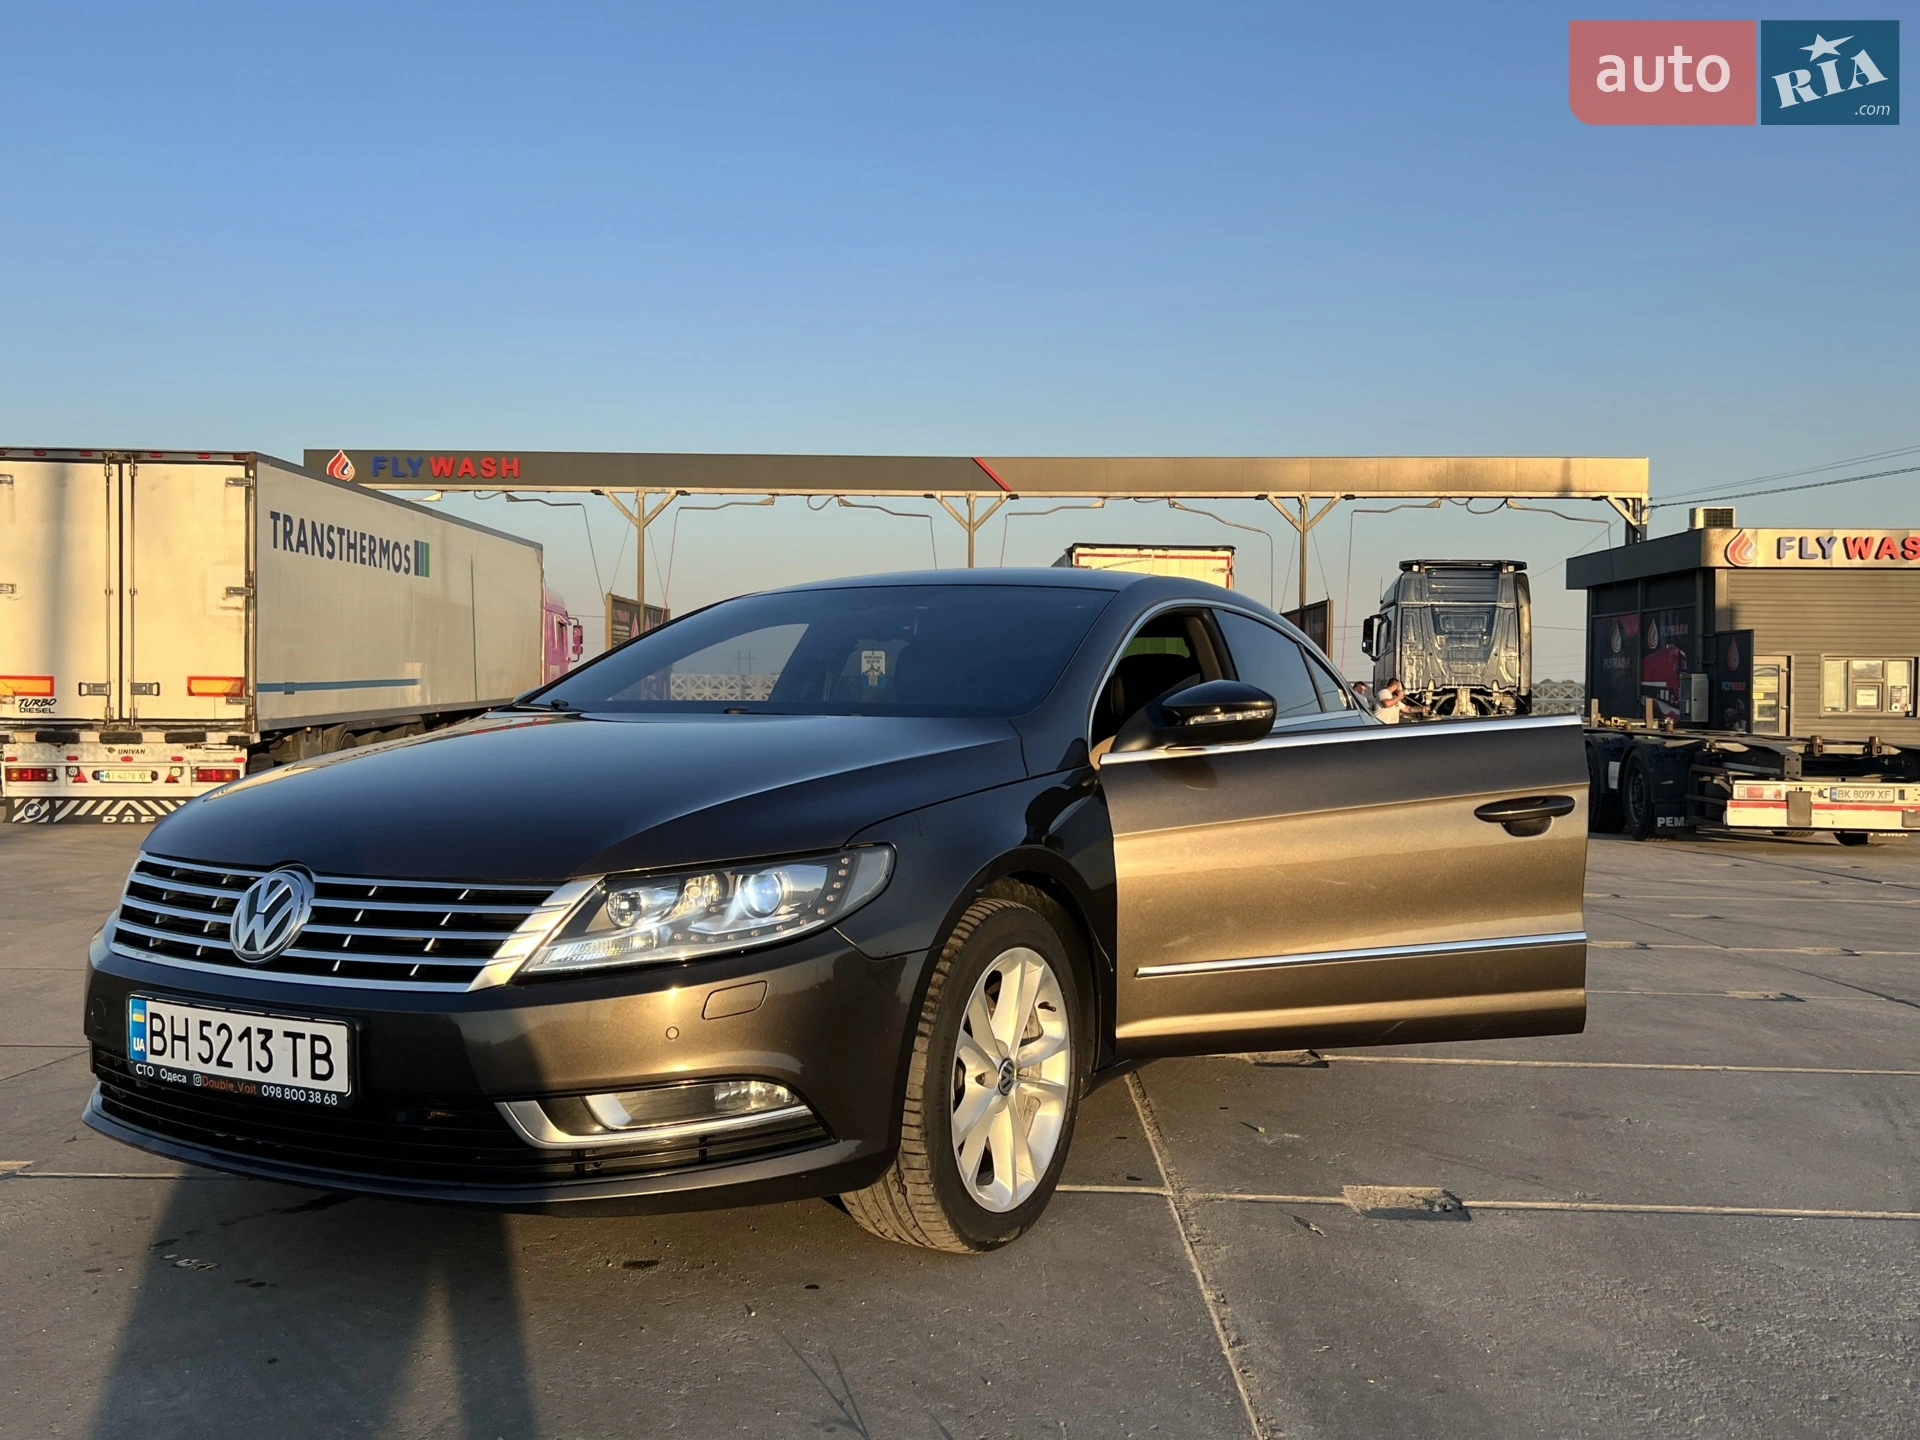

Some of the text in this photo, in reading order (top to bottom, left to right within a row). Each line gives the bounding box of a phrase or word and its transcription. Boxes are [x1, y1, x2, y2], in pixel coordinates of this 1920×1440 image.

[270, 510, 411, 575] TRANSTHERMOS
[18, 698, 57, 708] TURBO
[1837, 790, 1891, 799] BK 8099 XF
[1656, 816, 1688, 828] PEM
[133, 1037, 146, 1052] UA
[149, 1012, 335, 1082] BH 5213 TB
[160, 1068, 187, 1084] Одеса
[261, 1084, 338, 1105] 098 800 38 68
